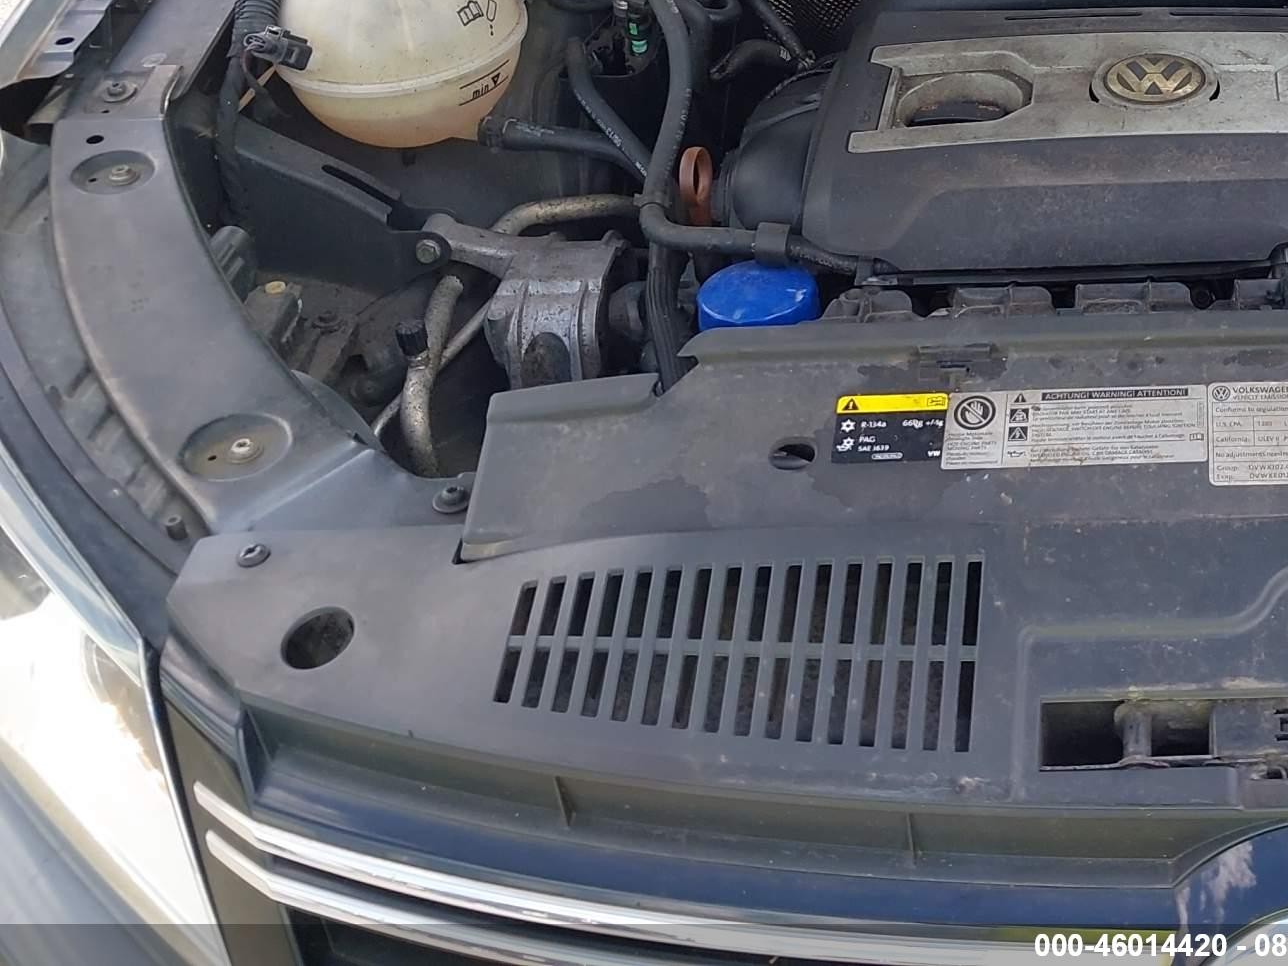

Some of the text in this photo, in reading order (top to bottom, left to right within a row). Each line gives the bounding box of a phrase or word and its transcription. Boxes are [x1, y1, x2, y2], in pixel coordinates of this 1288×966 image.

[472, 84, 489, 100] min
[1045, 388, 1186, 400] ACHTUNG! WARNING! ATTENTION!
